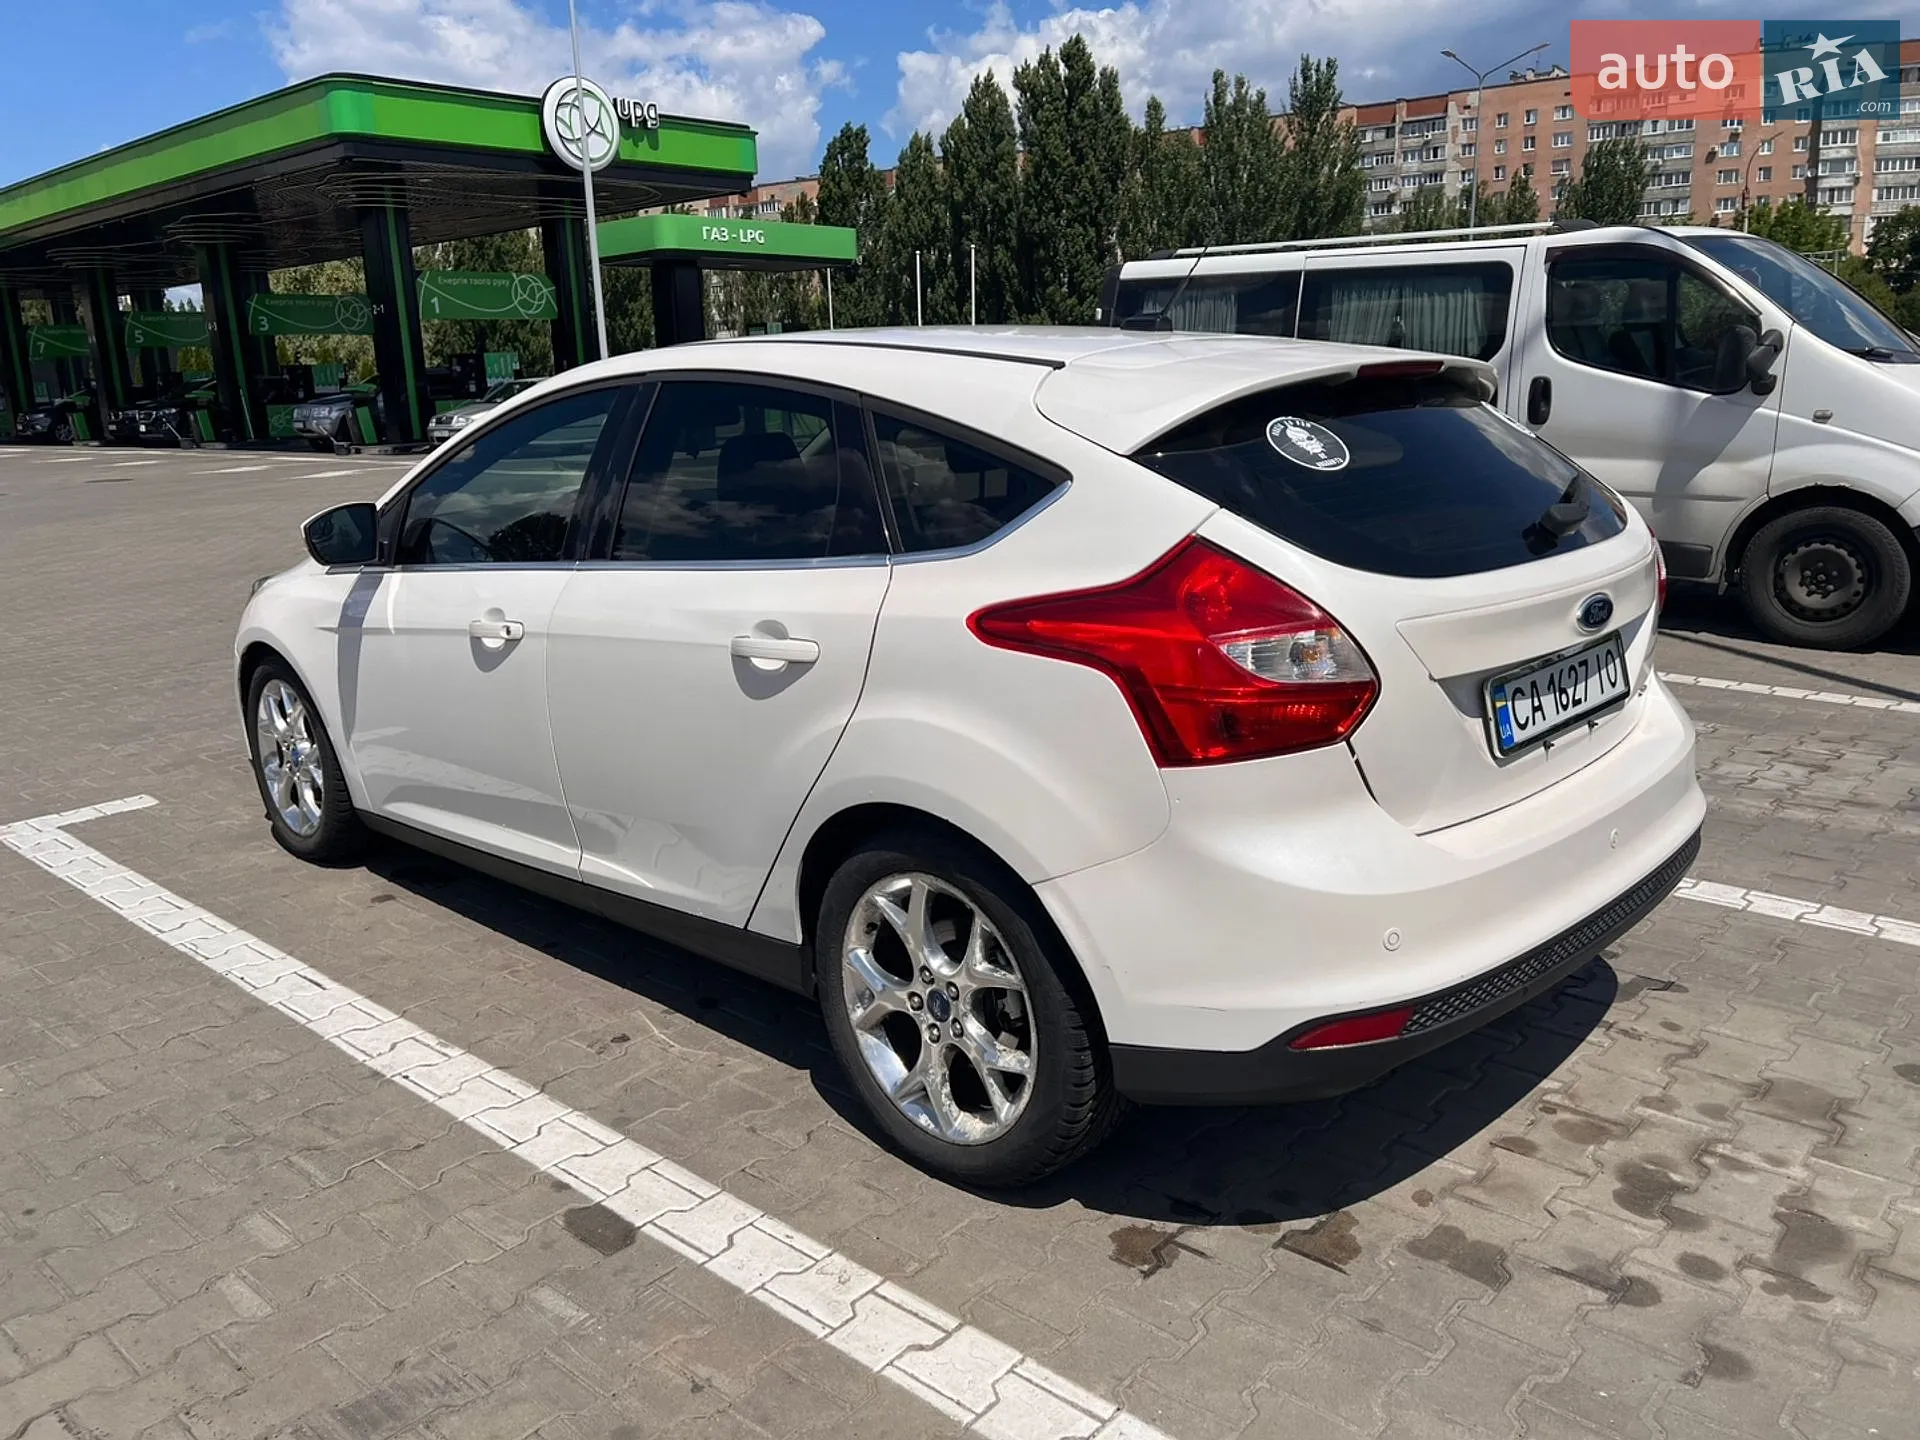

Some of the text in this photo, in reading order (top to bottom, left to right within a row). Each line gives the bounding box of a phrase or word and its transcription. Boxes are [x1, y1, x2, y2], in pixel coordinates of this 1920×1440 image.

[616, 98, 660, 129] upg
[430, 296, 440, 314] 1
[258, 316, 269, 332] 3
[134, 329, 144, 344] 5
[36, 341, 45, 354] 7
[1511, 679, 1546, 731] CA
[1547, 659, 1589, 715] 1627
